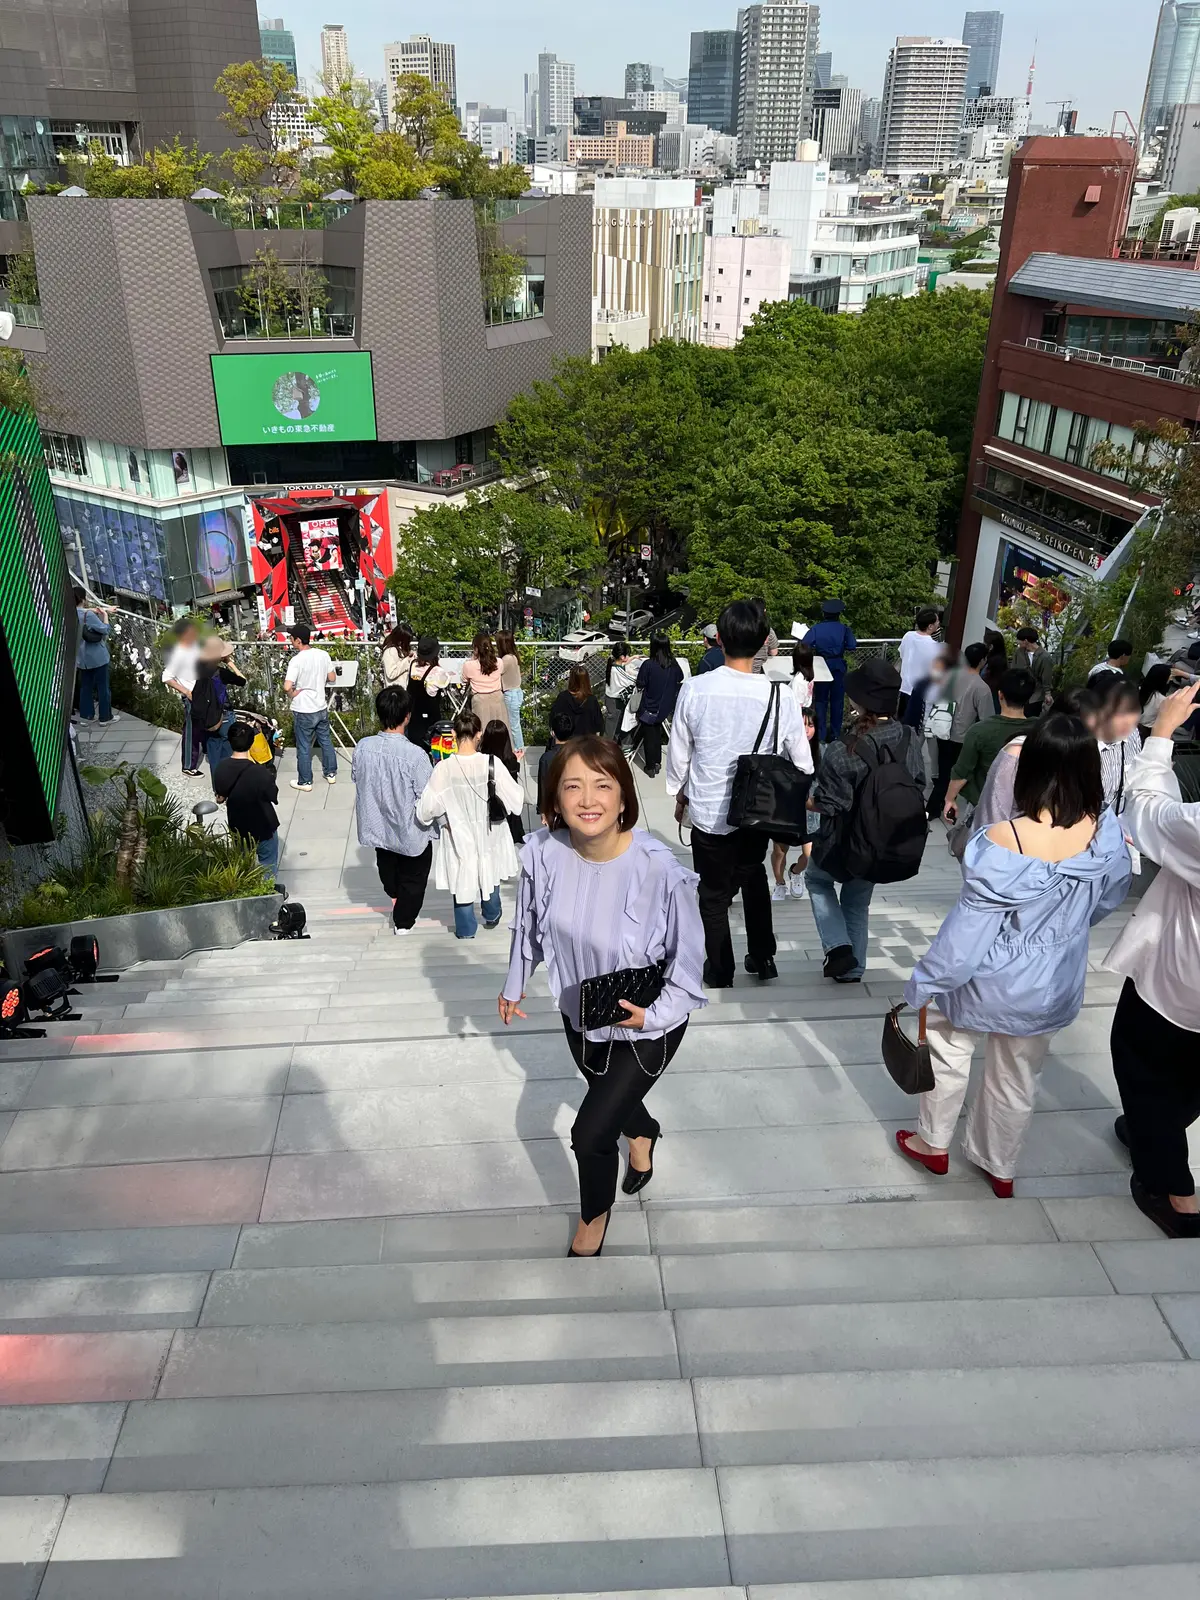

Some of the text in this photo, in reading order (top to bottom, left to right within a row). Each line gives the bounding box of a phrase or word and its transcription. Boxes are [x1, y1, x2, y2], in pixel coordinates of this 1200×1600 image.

[262, 424, 335, 433] いきもの東急不動産
[311, 520, 337, 528] OPEN
[1088, 553, 1104, 570] 焼
